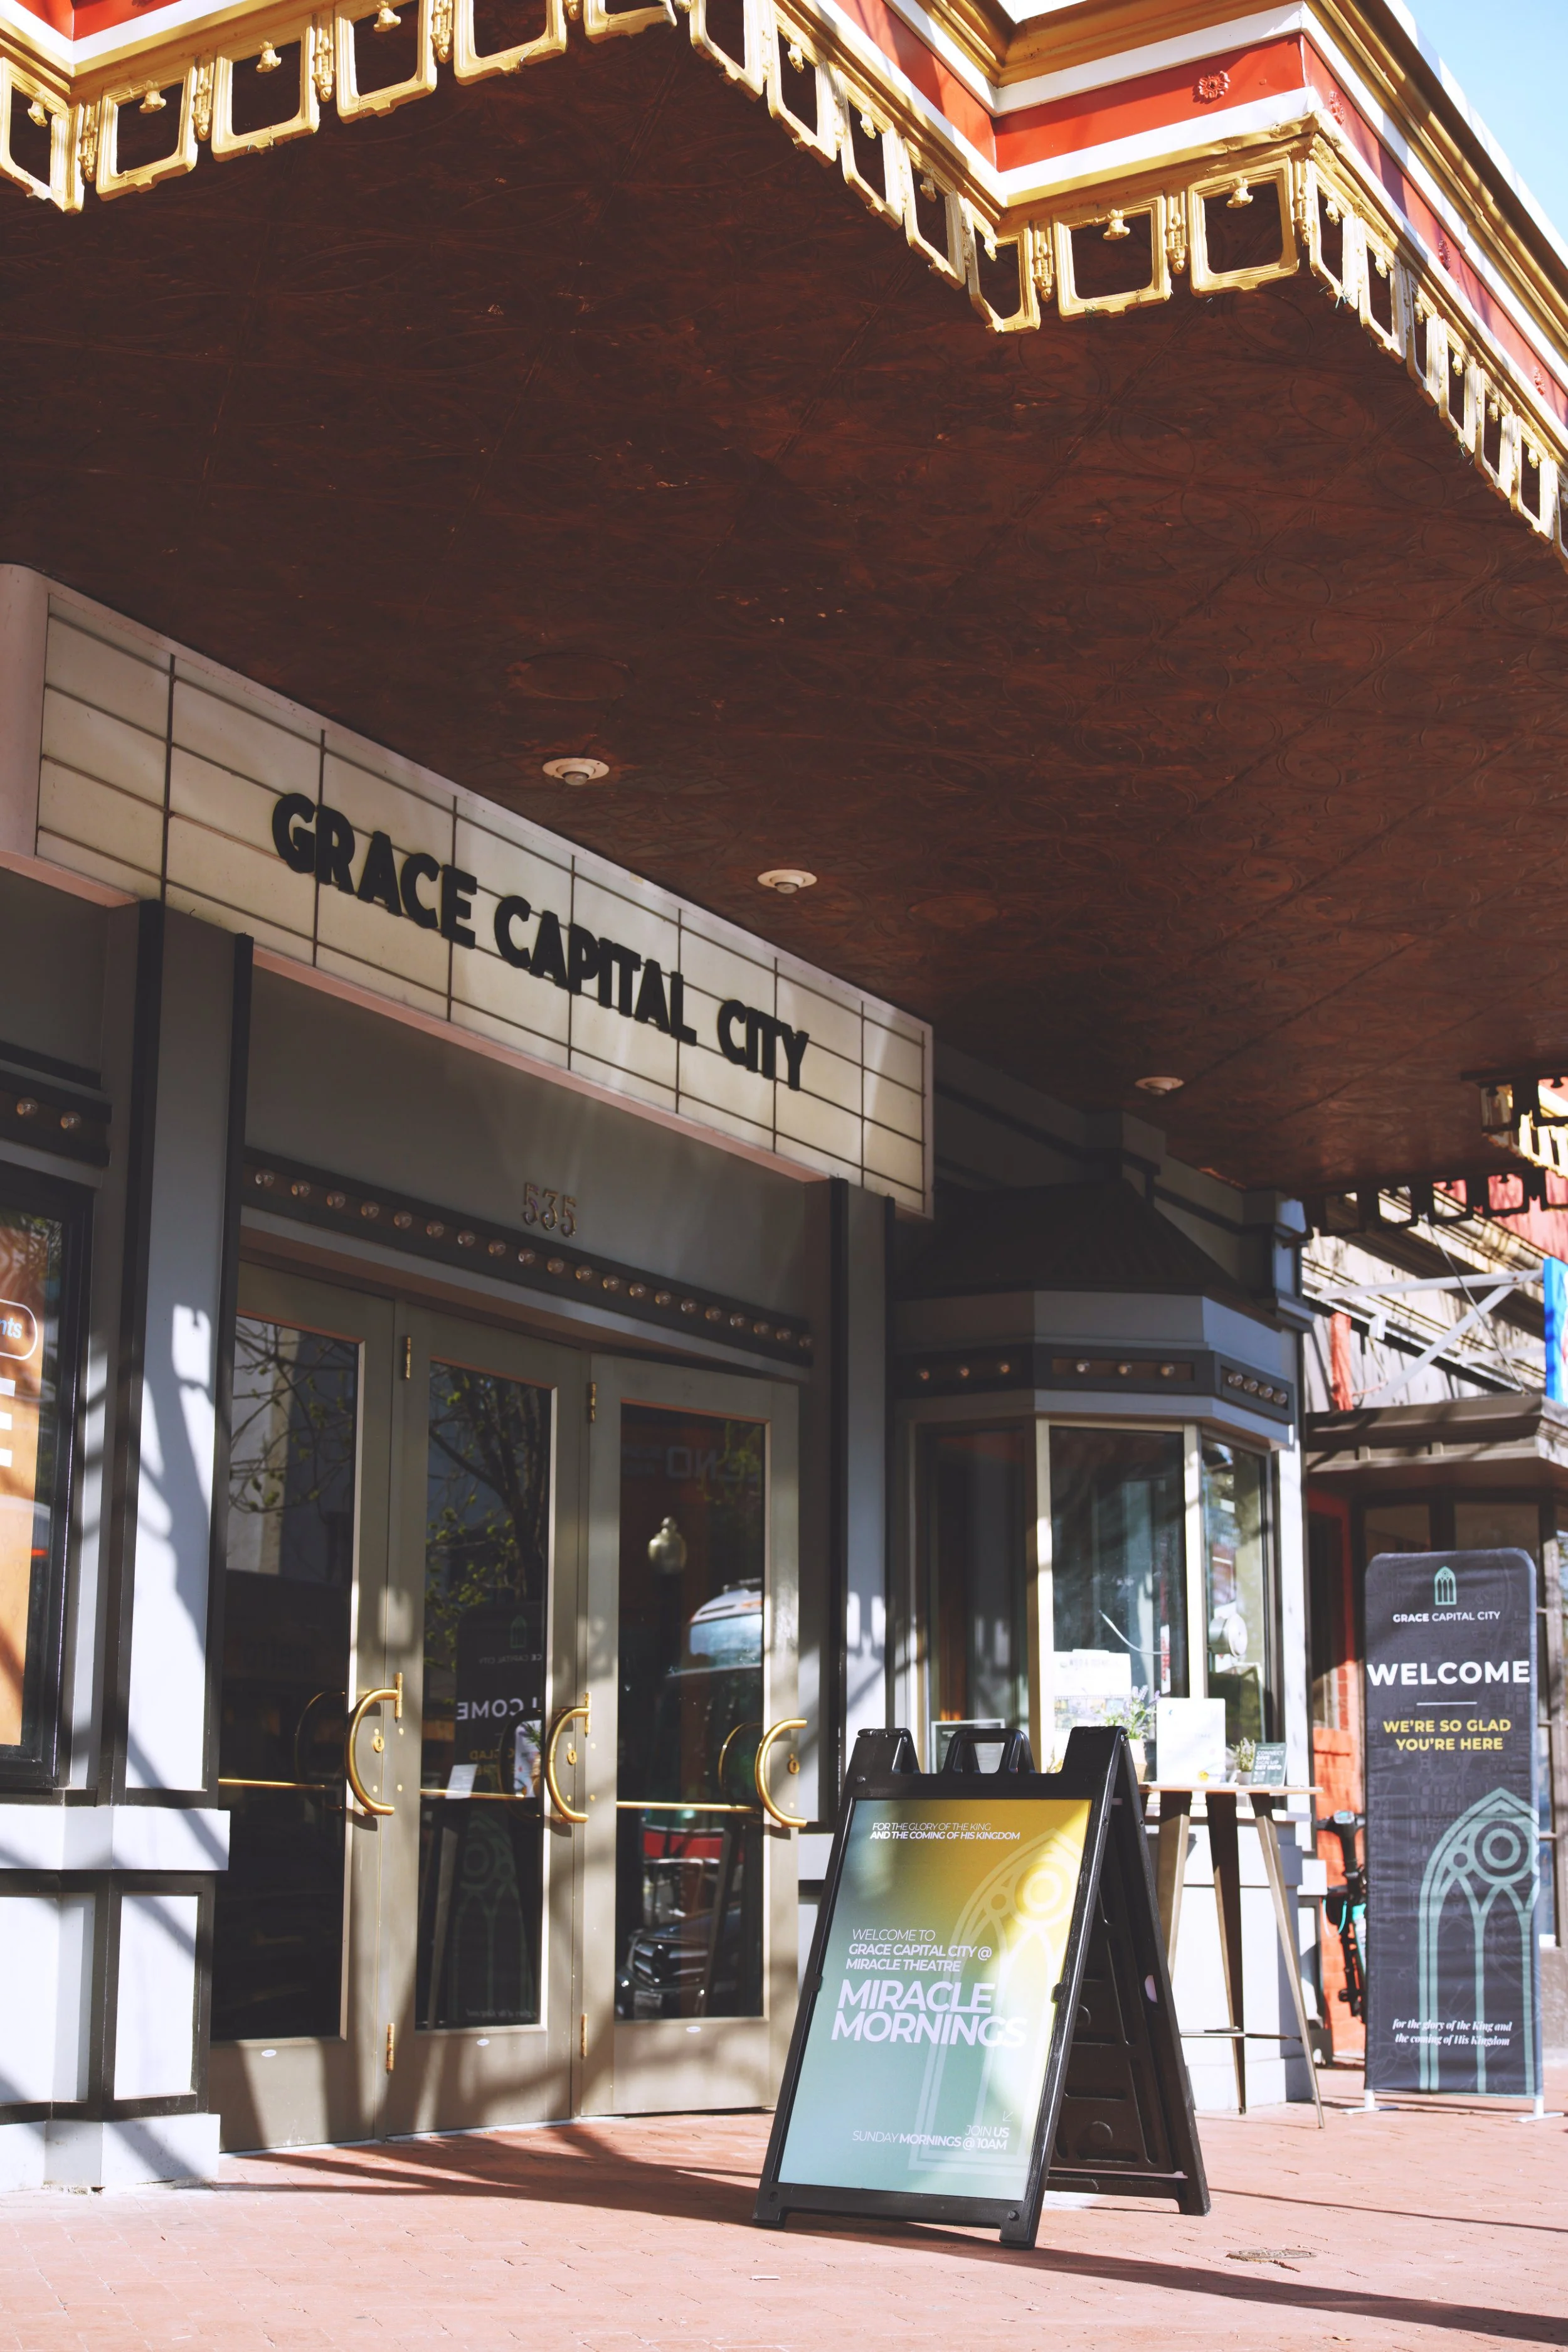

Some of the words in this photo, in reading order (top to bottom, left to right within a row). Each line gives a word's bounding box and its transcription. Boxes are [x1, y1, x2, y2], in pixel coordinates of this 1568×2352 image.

[272, 793, 477, 949] GRACE
[494, 895, 697, 1046] CAPITAL
[717, 999, 809, 1091] CITY
[522, 1182, 576, 1238] 535
[1392, 1613, 1429, 1623] GRACE
[1432, 1612, 1475, 1622] CAPITAL
[1477, 1610, 1501, 1620] CITY
[1367, 1661, 1530, 1686] WELCOME
[1383, 1720, 1434, 1733] WE'RE
[1439, 1719, 1462, 1732] SO
[1466, 1718, 1512, 1732] GLAD
[1396, 1738, 1455, 1751] YOU'RE
[1460, 1737, 1503, 1750] HERE
[872, 1823, 891, 1831] FOR
[892, 1823, 908, 1831] THE
[909, 1823, 938, 1831] GLORY
[938, 1823, 951, 1831] OF
[953, 1823, 969, 1831] THE
[970, 1823, 992, 1831] KING
[869, 1831, 891, 1839] AND
[892, 1831, 909, 1839] THE
[909, 1831, 946, 1839] COMING
[946, 1831, 960, 1839] OF
[960, 1831, 975, 1839] HIS
[975, 1831, 1020, 1840] KINGDOM
[852, 1929, 917, 1942] WELCOME
[919, 1929, 936, 1942] TO
[849, 1944, 892, 1956] GRACE
[893, 1944, 946, 1957] CAPITAL
[948, 1945, 977, 1957] CITY
[977, 1946, 992, 1961] @
[845, 1958, 904, 1971] MIRACLE
[903, 1959, 961, 1972] THEATRE
[837, 1979, 995, 2014] MIRACLE
[831, 2011, 1029, 2048] MORNINGS
[1392, 2018, 1407, 2030] for
[1407, 2019, 1421, 2029] the
[1422, 2019, 1444, 2031] glory
[1446, 2019, 1457, 2031] of
[1457, 2020, 1471, 2031] the
[1472, 2021, 1493, 2033] King
[1494, 2021, 1512, 2031] and
[1395, 2033, 1409, 2043] the
[1410, 2034, 1443, 2046] coming
[1443, 2034, 1454, 2046] of
[1454, 2034, 1470, 2045] His
[1471, 2035, 1510, 2046] Kingdom
[965, 2125, 992, 2136] JOIN
[993, 2127, 1010, 2138] US
[852, 2131, 900, 2142] SUNDAY
[899, 2134, 962, 2147] MORNINGS
[963, 2137, 976, 2151] @
[977, 2137, 1007, 2150] 10AM
